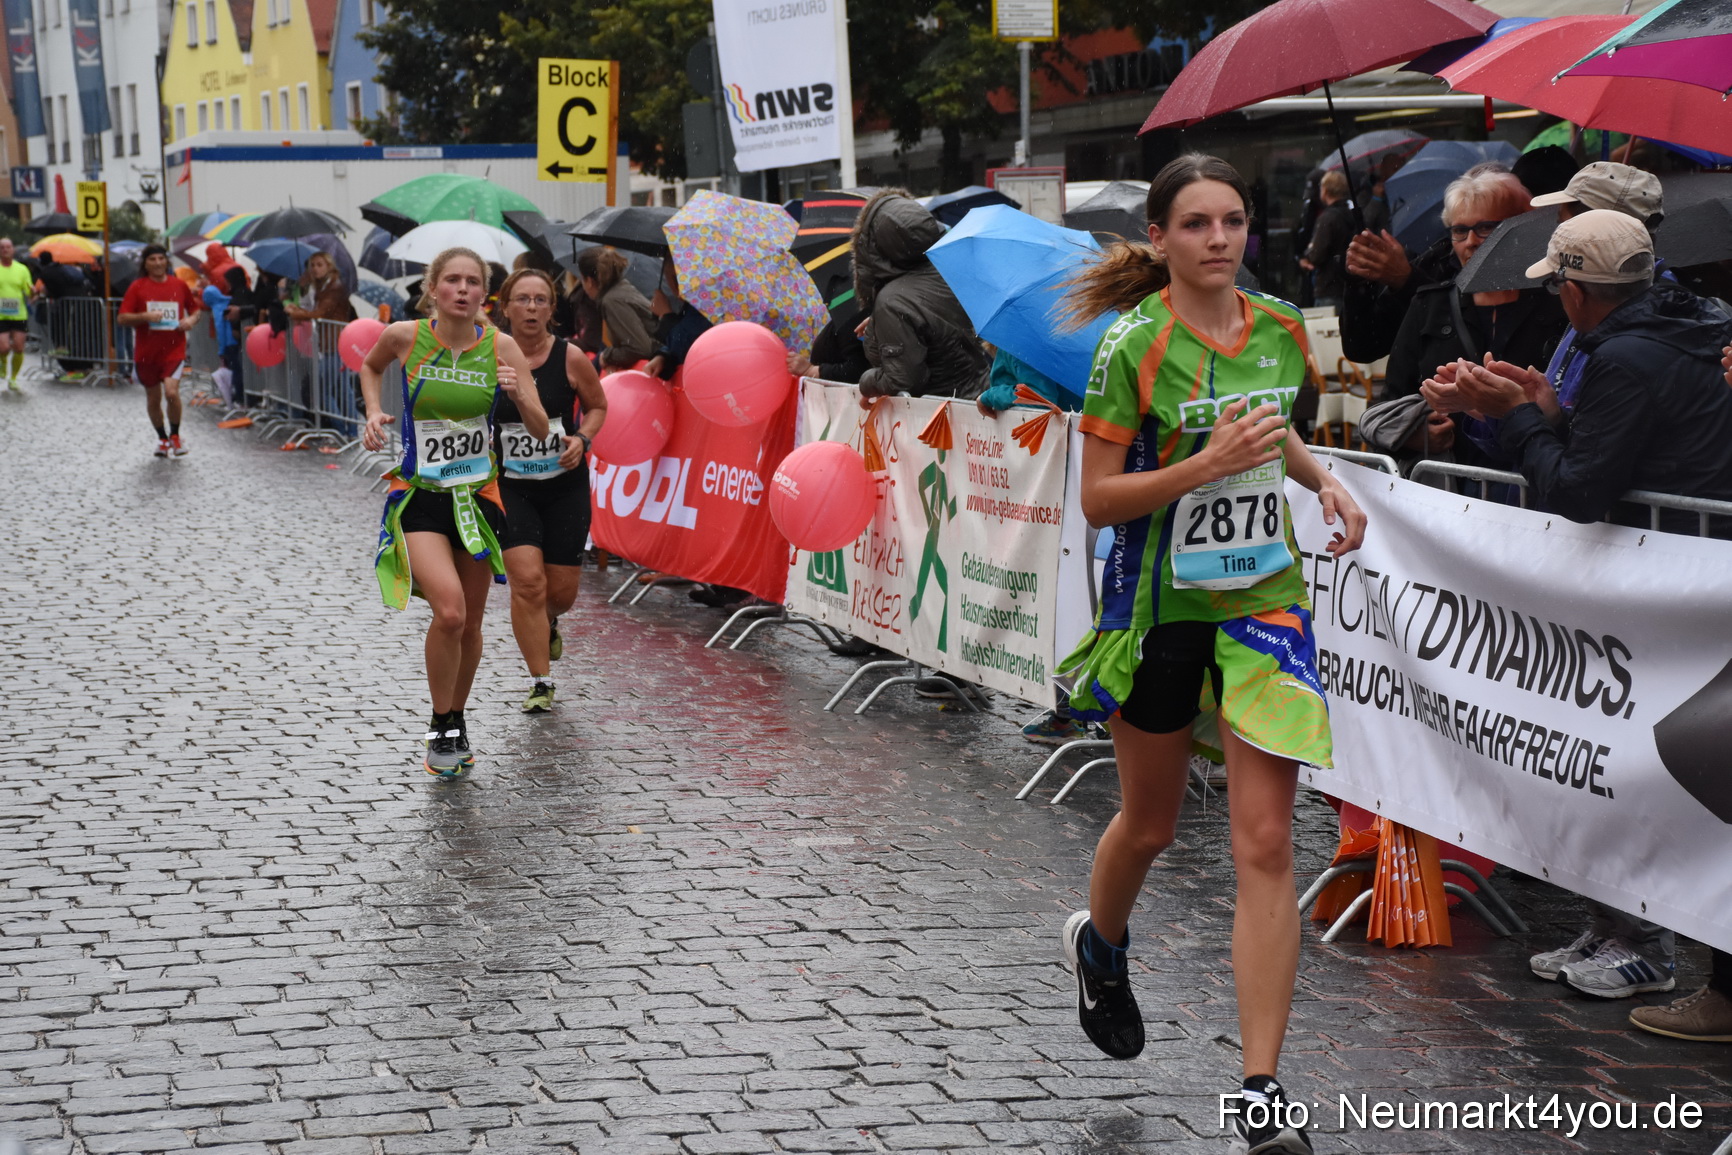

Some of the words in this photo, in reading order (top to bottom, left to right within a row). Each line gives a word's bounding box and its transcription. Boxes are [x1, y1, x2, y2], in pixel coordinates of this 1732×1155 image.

[548, 64, 609, 88] Block
[557, 96, 597, 156] C
[84, 196, 100, 219] D
[418, 364, 488, 388] BOCK
[425, 430, 484, 463] 2830
[507, 432, 561, 458] 2344
[440, 463, 472, 478] Kerstin
[452, 484, 481, 547] OCK
[1184, 492, 1279, 546] 2878
[1220, 554, 1256, 573] Tina
[960, 593, 1039, 639] Hausmeisterdienst
[1408, 677, 1456, 742] MEHR
[1453, 699, 1615, 800] FAHRFREUDE.
